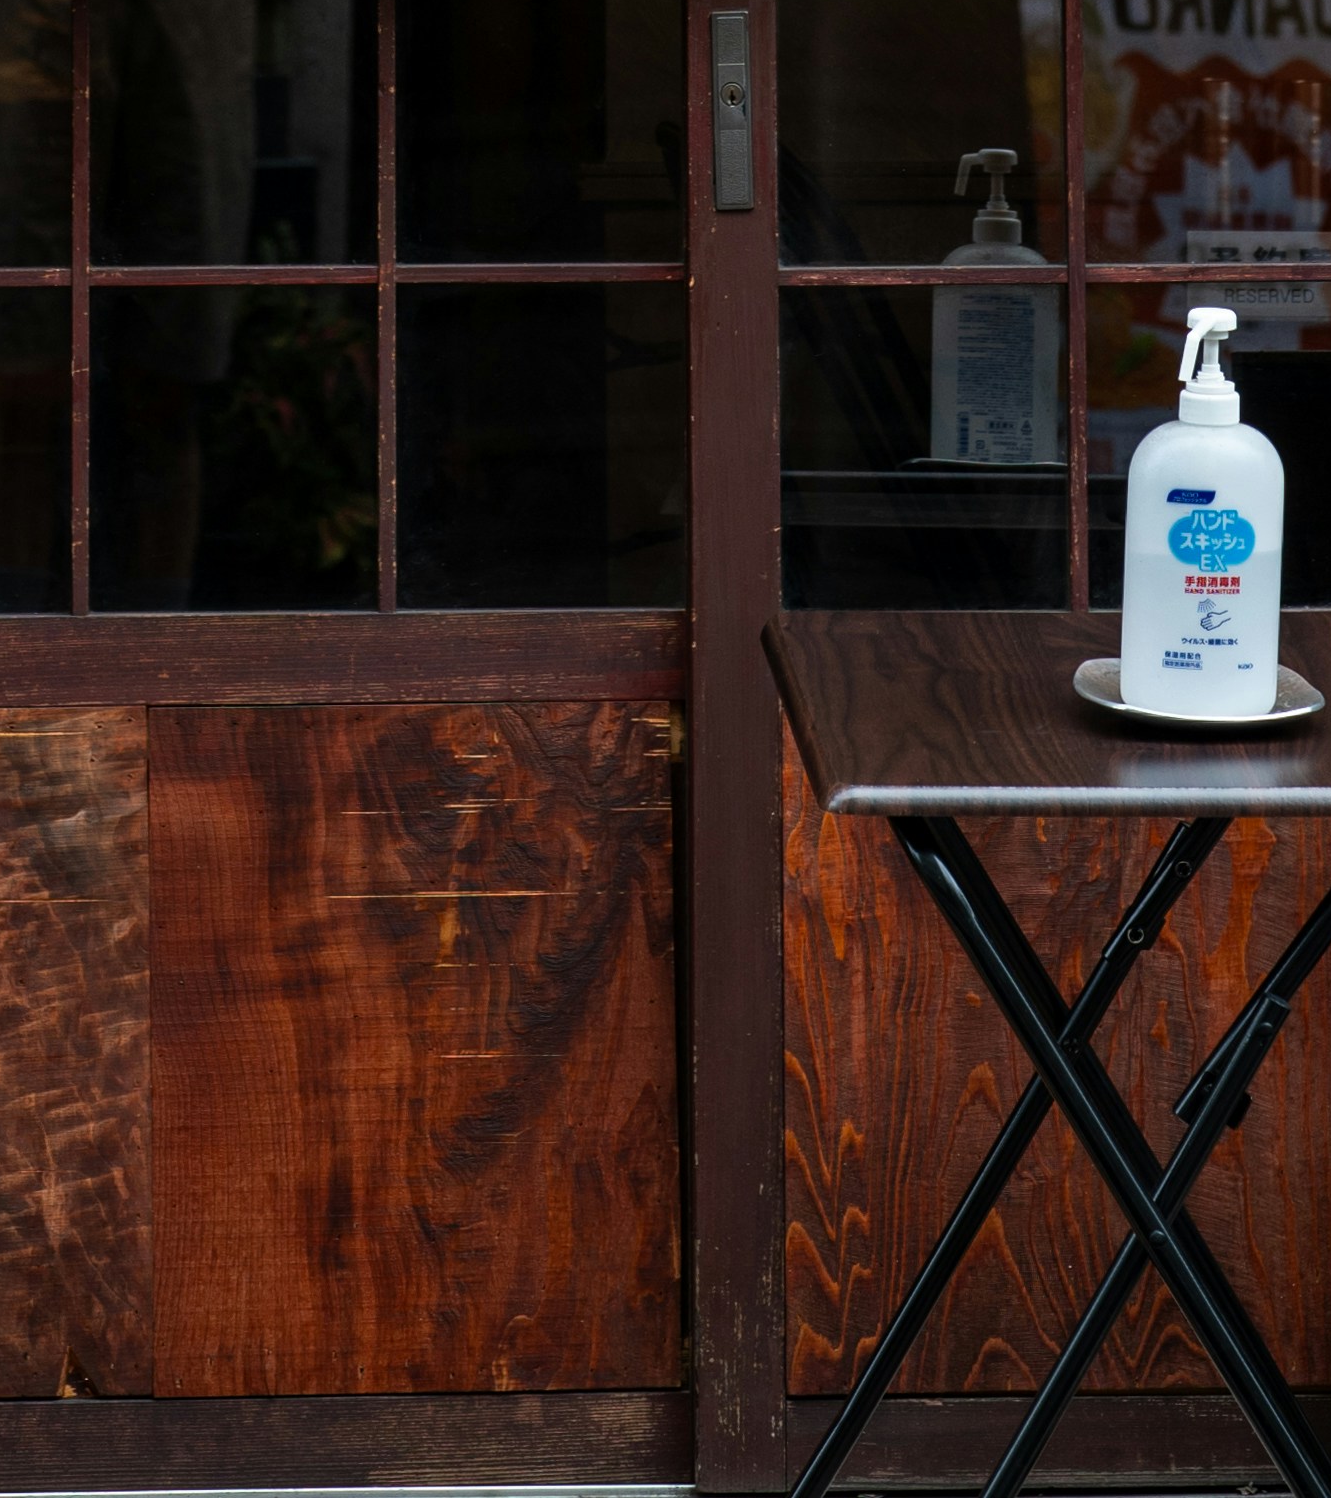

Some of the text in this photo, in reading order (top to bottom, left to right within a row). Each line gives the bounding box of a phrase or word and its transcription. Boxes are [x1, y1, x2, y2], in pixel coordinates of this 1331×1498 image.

[1224, 288, 1315, 304] RESERVED
[1191, 510, 1235, 531] ハンド
[1179, 532, 1246, 551] スキッシュ
[1200, 553, 1227, 571] EX
